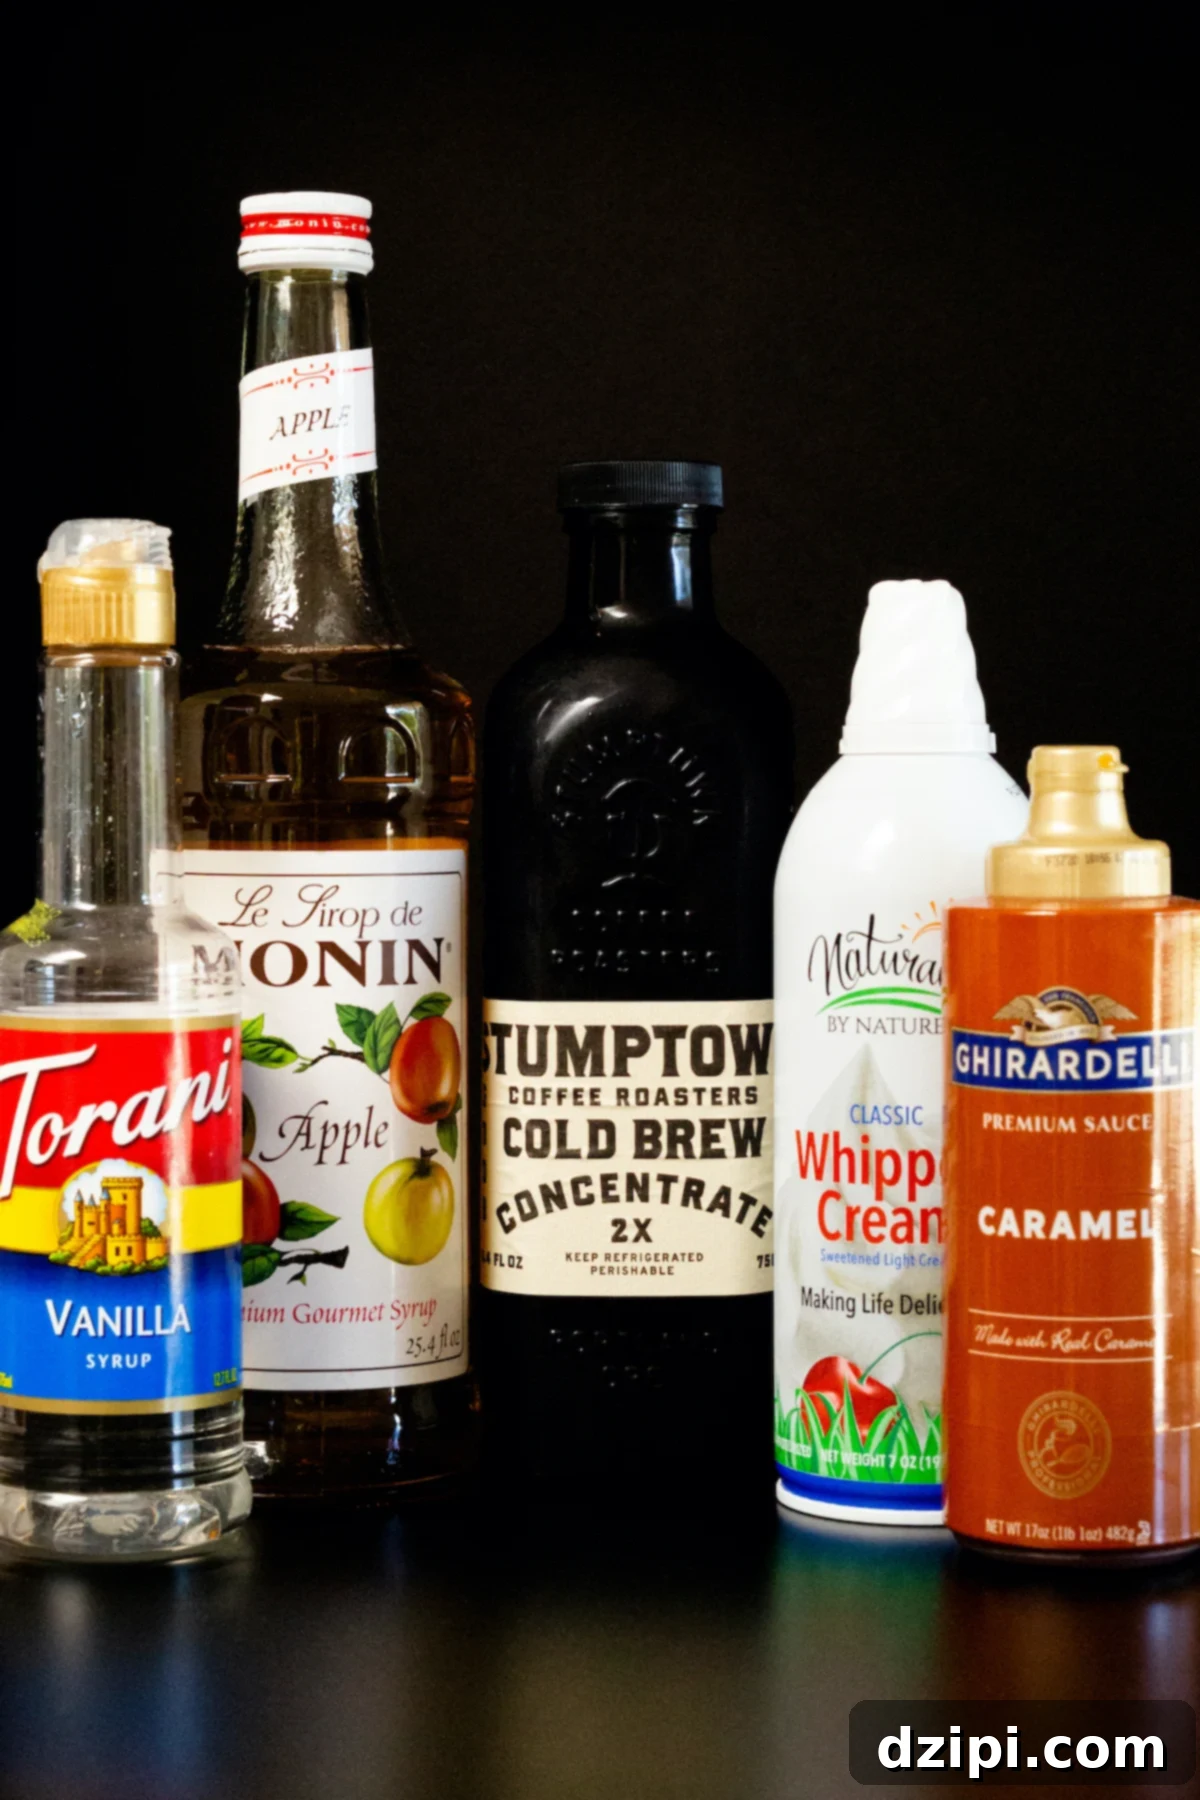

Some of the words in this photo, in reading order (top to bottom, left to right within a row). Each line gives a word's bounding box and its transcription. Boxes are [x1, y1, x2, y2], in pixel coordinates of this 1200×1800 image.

[269, 404, 352, 441] APPLE
[218, 883, 274, 928] Le
[282, 883, 380, 938] Sirop
[390, 901, 423, 926] de
[807, 914, 944, 996] Natura
[827, 1016, 850, 1033] BY
[856, 1017, 944, 1035] NATURE
[956, 1041, 1189, 1079] GHIRARDELLI
[508, 1086, 602, 1107] COFFEE
[616, 1086, 758, 1107] ROASTERS
[0, 1037, 231, 1200] Torani
[849, 1104, 924, 1126] CLASSIC
[982, 1112, 1076, 1133] PREMIUM
[1083, 1112, 1153, 1132] SAUCE
[259, 1100, 389, 1166] Apple
[503, 1117, 616, 1159] COLD
[633, 1116, 766, 1159] BREW
[795, 1129, 943, 1202] Whipp
[496, 1172, 773, 1239] CONCENTRATE
[610, 1217, 652, 1243] 2X
[978, 1205, 1158, 1240] CARAMEL
[507, 1254, 523, 1269] OZ
[565, 1252, 598, 1263] KEEP
[604, 1252, 704, 1263] REFRIGERATED
[590, 1265, 675, 1276] PERISHABLE
[820, 1248, 880, 1266] Sweetened
[884, 1250, 915, 1270] Light
[292, 1301, 385, 1325] Gourmet
[390, 1297, 438, 1331] Syrup
[801, 1286, 856, 1318] Making
[862, 1292, 894, 1315] Life
[45, 1299, 191, 1338] VANILLA
[405, 1334, 436, 1358] 25.4
[974, 1323, 1013, 1347] Made
[1016, 1330, 1046, 1349] with
[1051, 1327, 1091, 1353] Real
[85, 1353, 152, 1369] SYRUP
[841, 1451, 886, 1468] WEIGHT
[985, 1518, 1004, 1535] NET
[1006, 1520, 1021, 1536] WT
